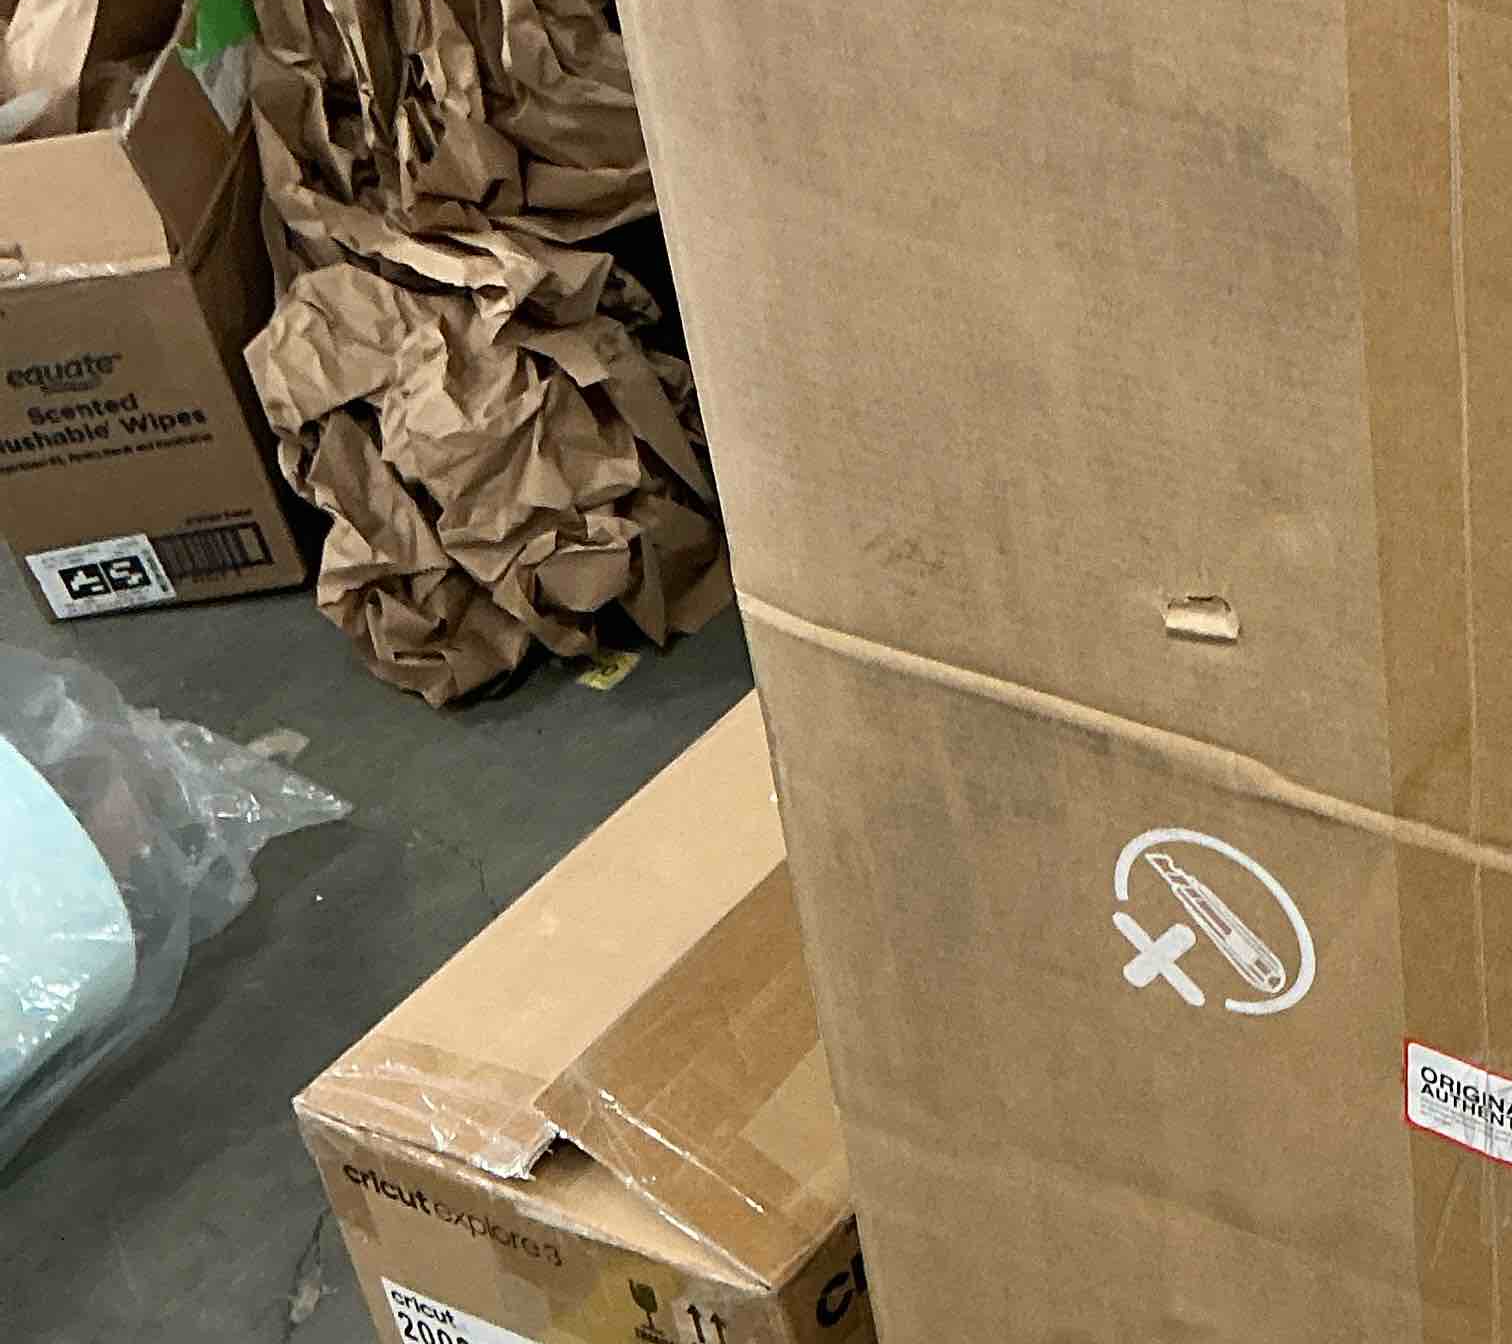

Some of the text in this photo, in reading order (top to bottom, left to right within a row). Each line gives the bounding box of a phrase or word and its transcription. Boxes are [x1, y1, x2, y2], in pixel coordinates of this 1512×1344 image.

[119, 408, 207, 435] Wipes
[343, 1164, 431, 1215] cricut
[391, 1290, 456, 1328] cricut
